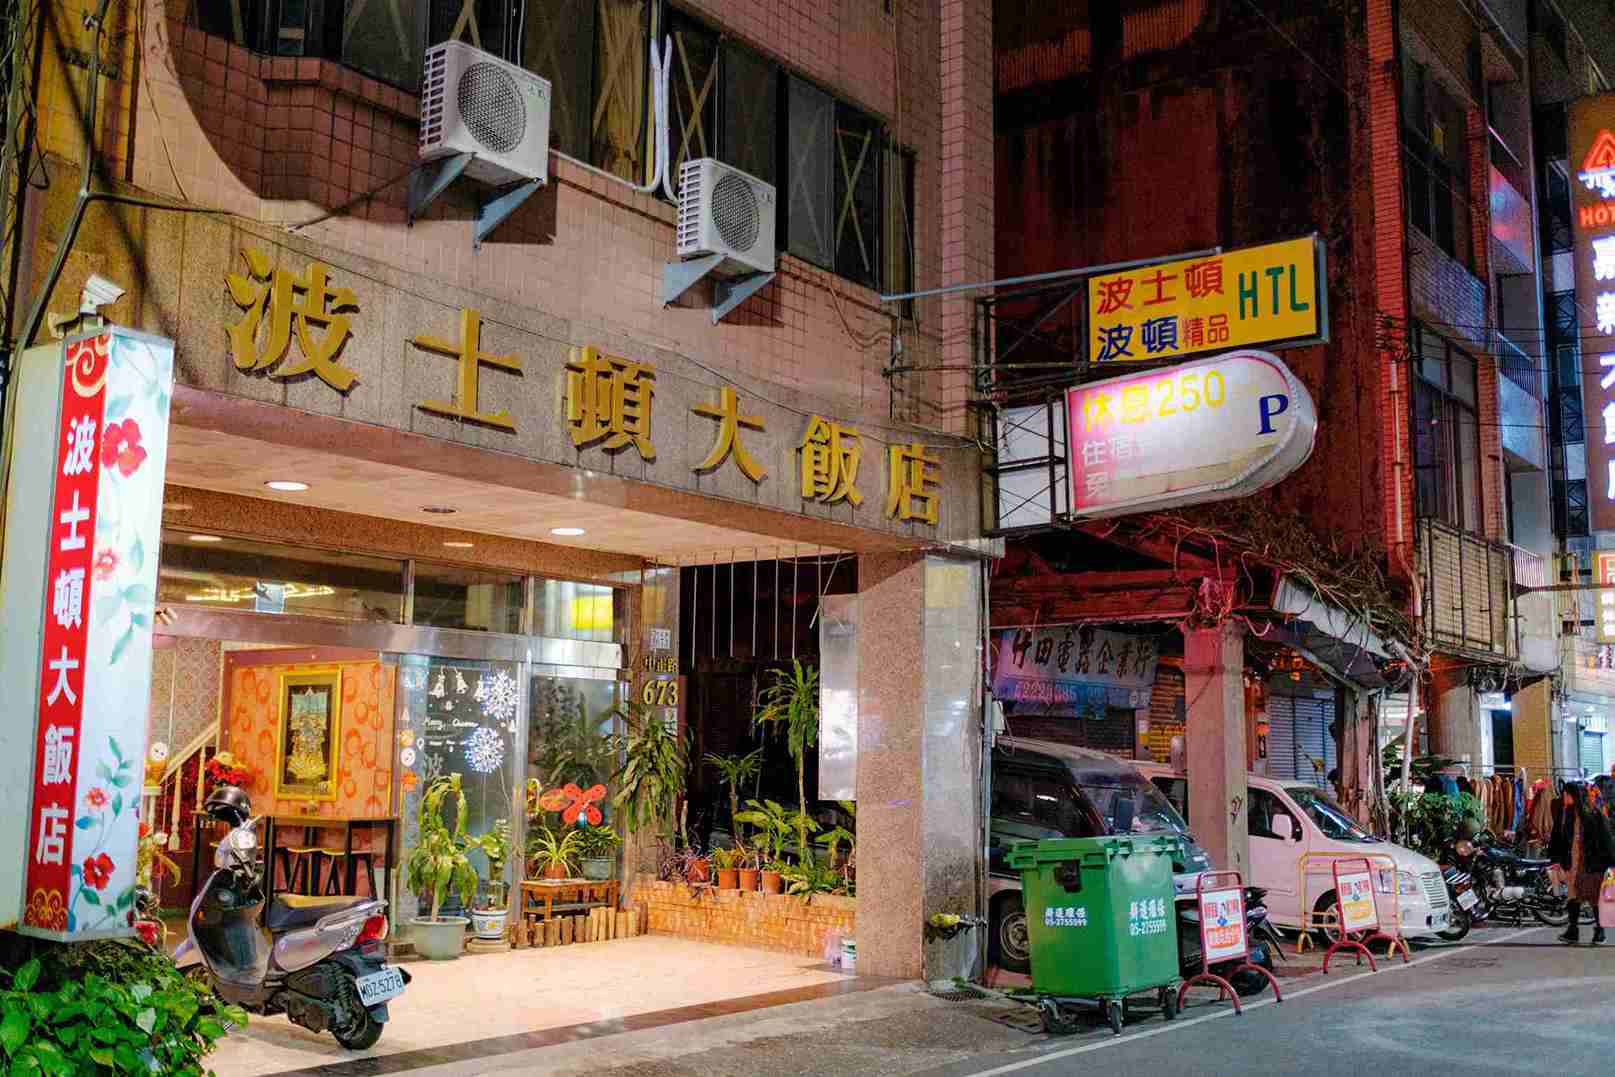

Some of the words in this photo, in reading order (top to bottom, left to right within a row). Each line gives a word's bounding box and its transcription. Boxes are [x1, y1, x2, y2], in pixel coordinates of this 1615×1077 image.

[1097, 259, 1225, 314] 波士頓
[1238, 264, 1310, 321] HTL
[224, 247, 940, 525] 波士頓大飯店
[1256, 393, 1289, 436] P
[36, 415, 96, 866] 波士頓大飯店
[643, 679, 679, 705] 673
